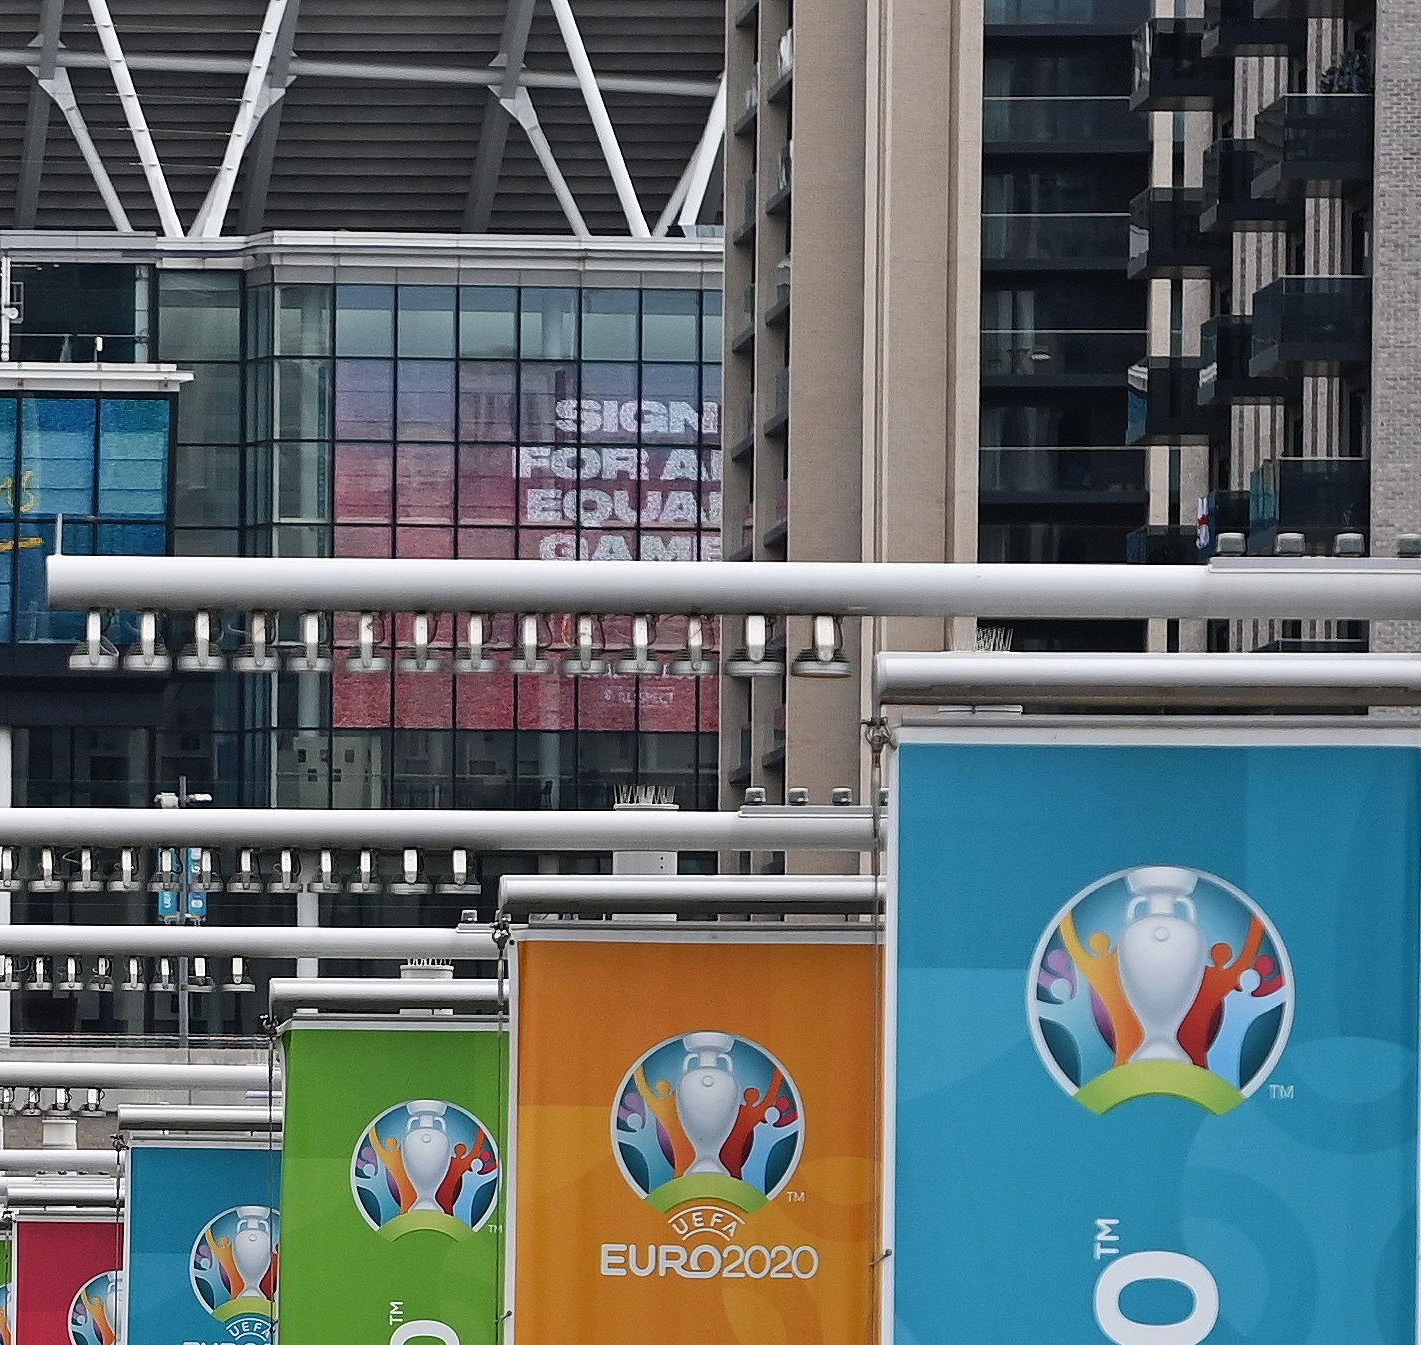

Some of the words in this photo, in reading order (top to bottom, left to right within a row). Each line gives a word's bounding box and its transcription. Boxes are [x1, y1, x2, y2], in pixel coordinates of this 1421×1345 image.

[555, 400, 720, 434] SIGN
[512, 446, 650, 482] FOR
[673, 1211, 740, 1238] UEFA
[601, 1243, 819, 1279] EURO2020
